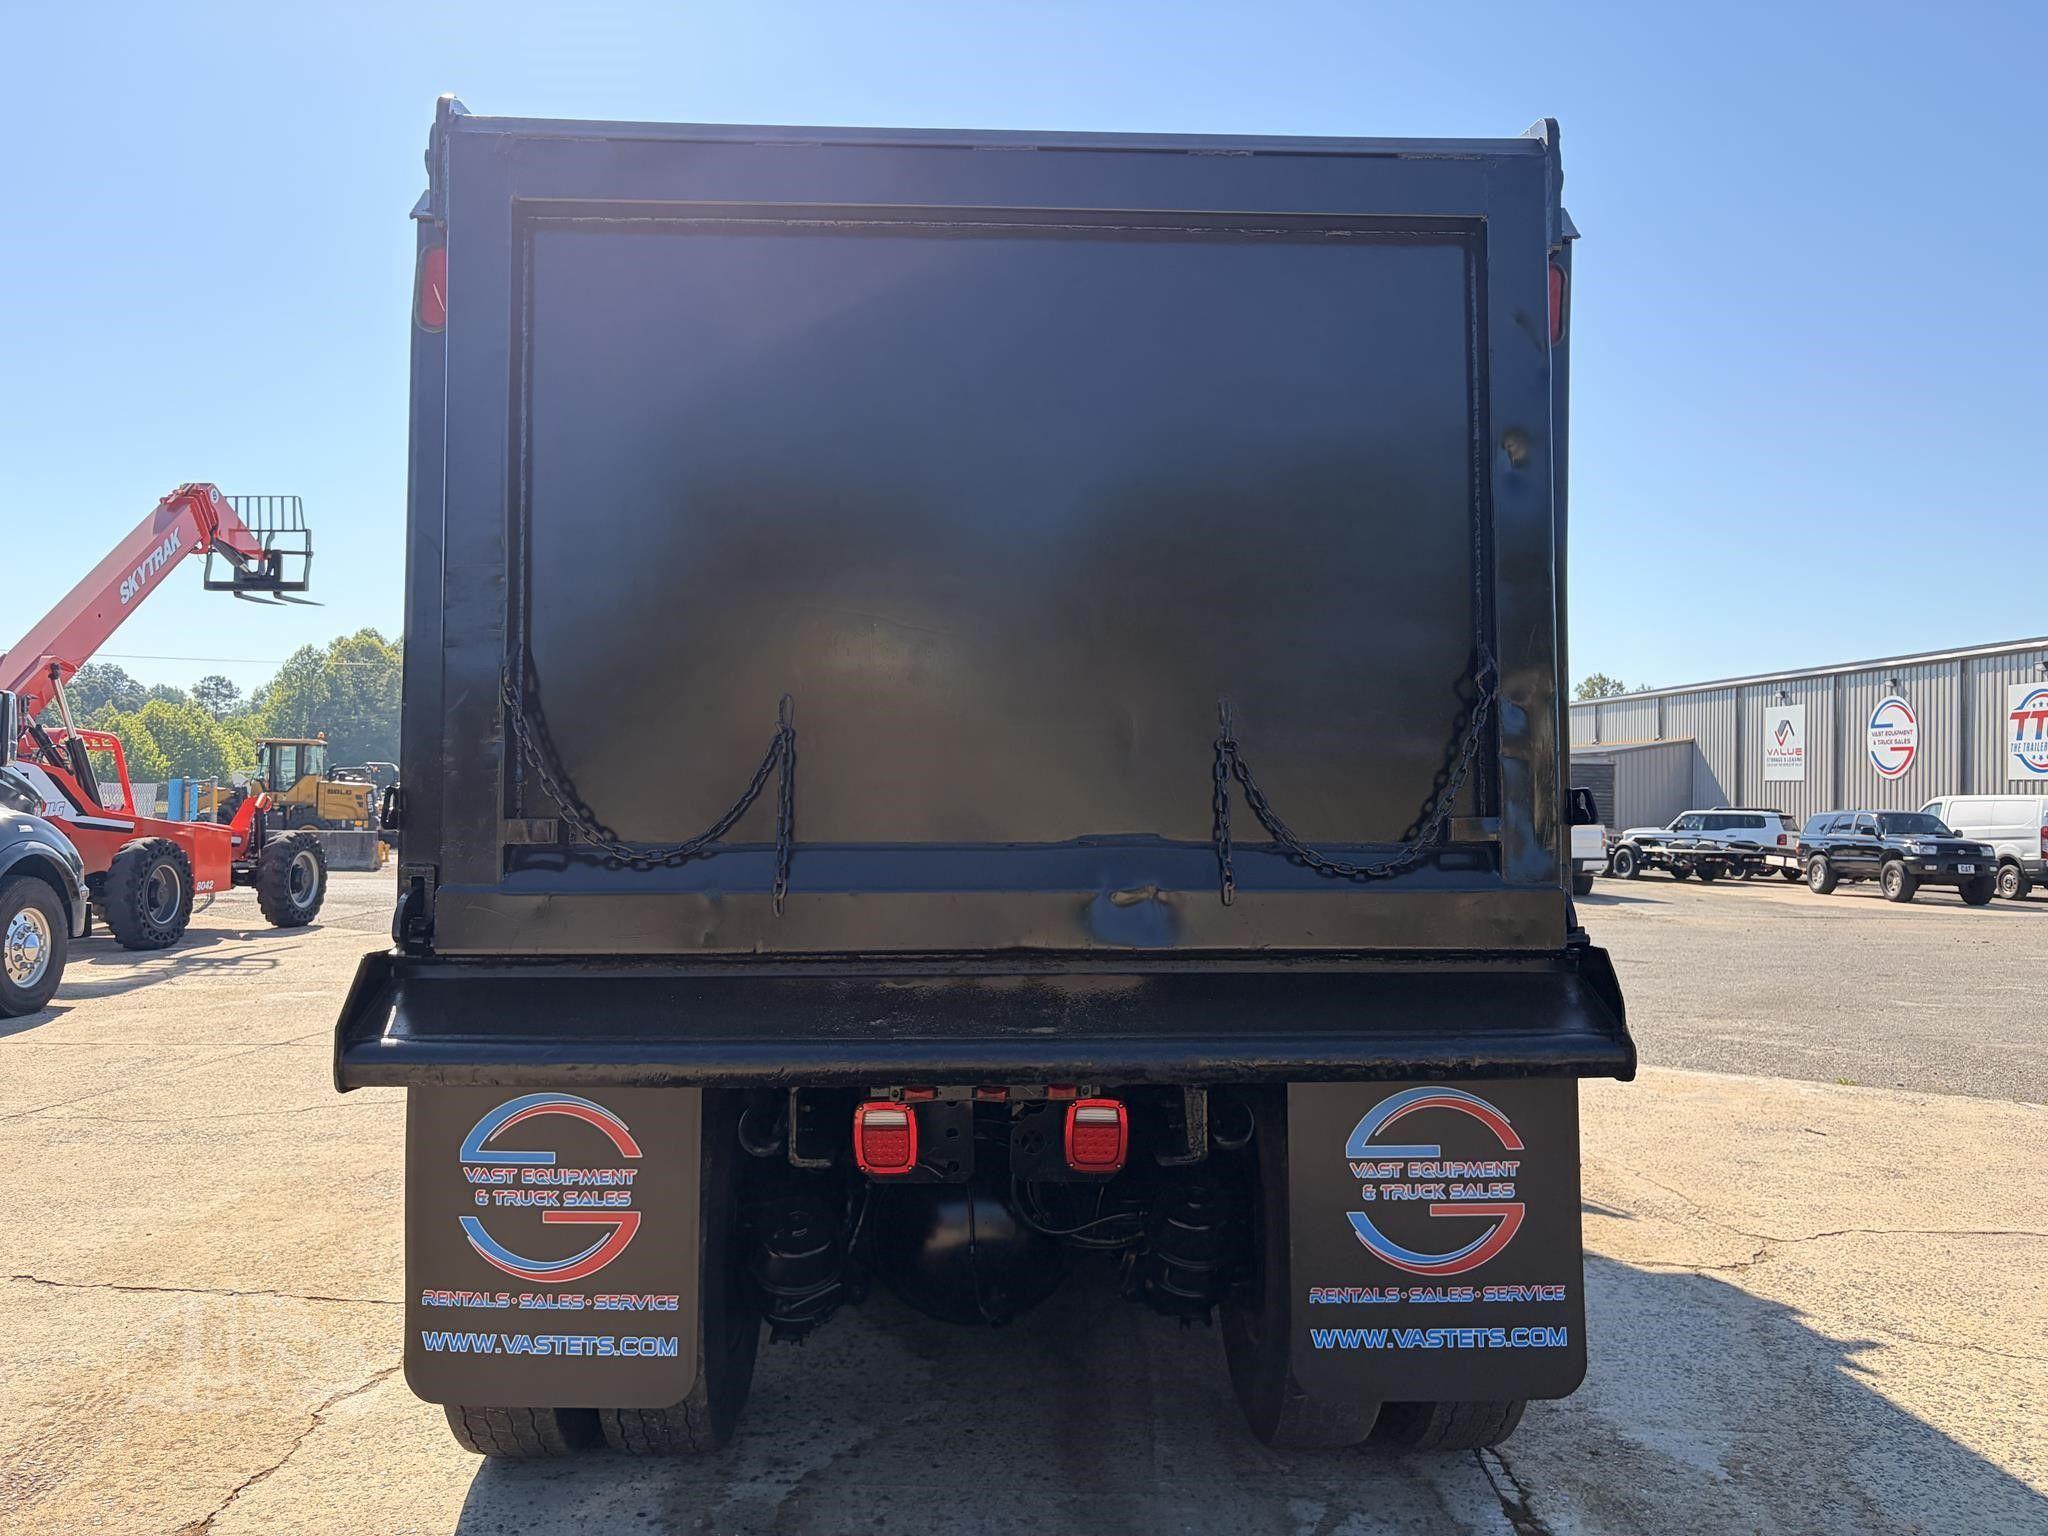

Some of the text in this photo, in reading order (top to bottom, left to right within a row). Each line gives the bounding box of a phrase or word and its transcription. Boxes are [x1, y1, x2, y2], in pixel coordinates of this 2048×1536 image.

[120, 527, 182, 605] SKYTRAK
[2010, 710, 2048, 740] TT
[1767, 747, 1803, 756] VALUE
[2010, 743, 2021, 753] THE
[463, 1167, 638, 1186] VAST EQUIPMENT
[1349, 1161, 1520, 1179] VAST EQUIPMENT
[474, 1189, 632, 1207] & TRUCK SALES
[1362, 1182, 1516, 1201] & TRUCK SALES
[421, 1331, 679, 1357] WWW.VASTETS.COM
[1310, 1326, 1568, 1349] WWW.VASTETS.COM
